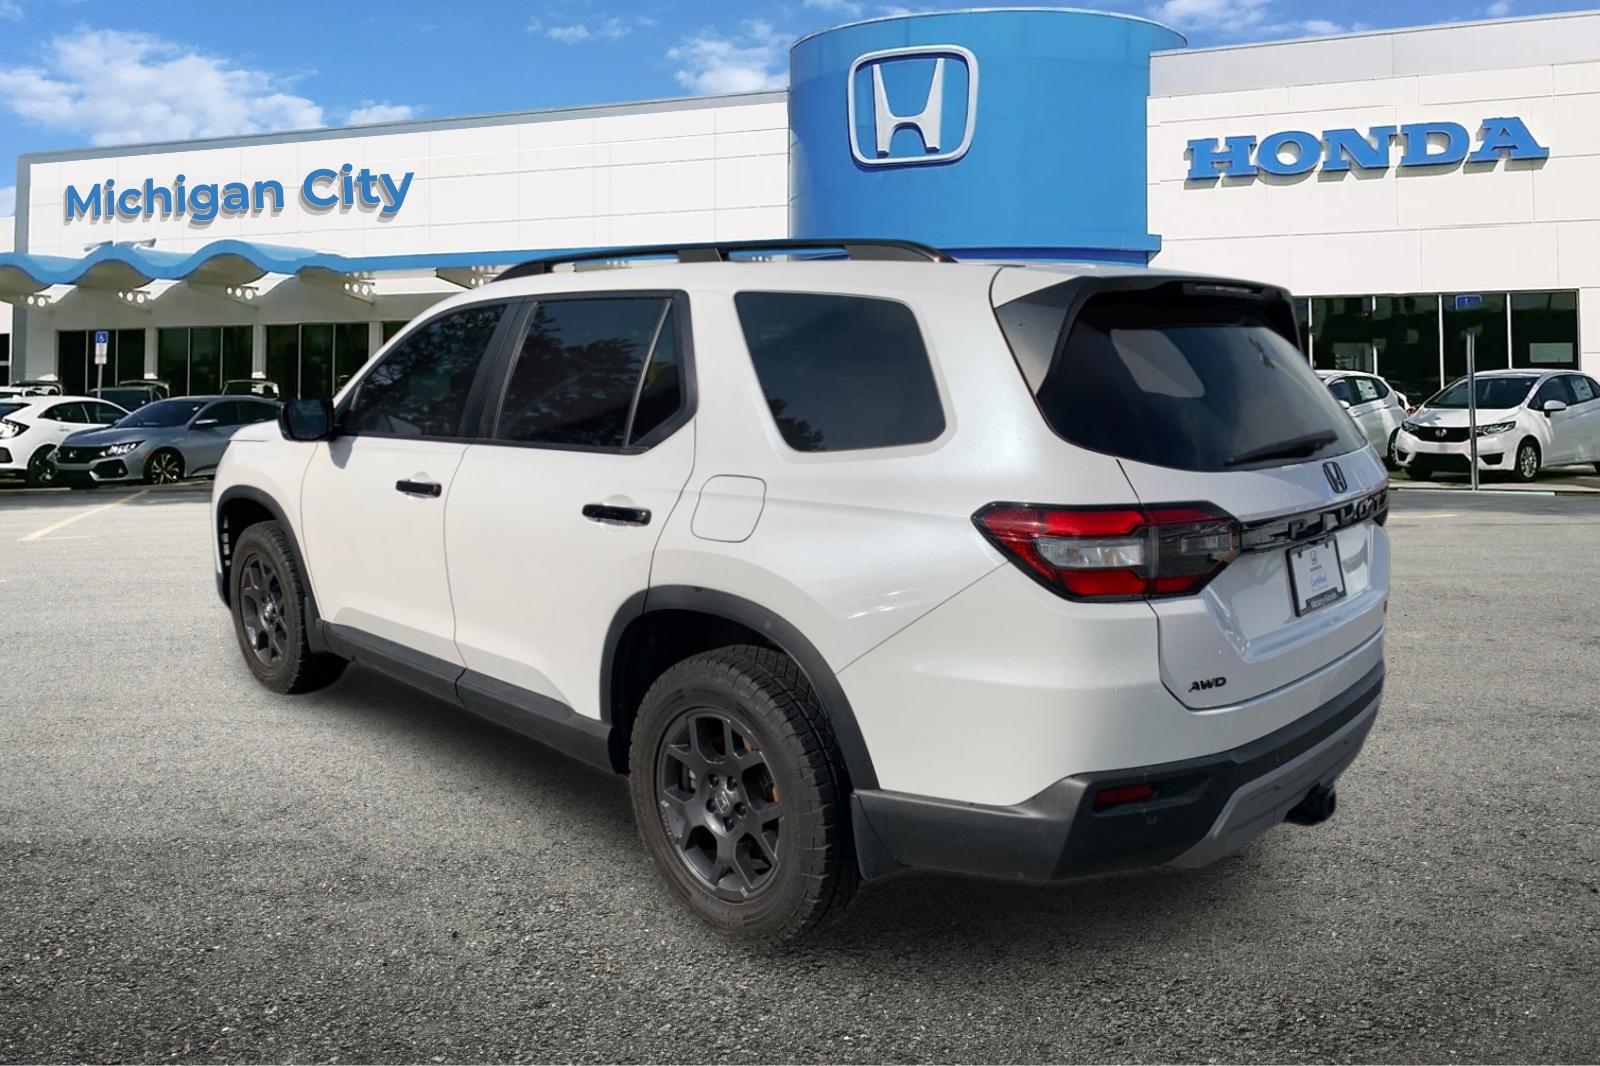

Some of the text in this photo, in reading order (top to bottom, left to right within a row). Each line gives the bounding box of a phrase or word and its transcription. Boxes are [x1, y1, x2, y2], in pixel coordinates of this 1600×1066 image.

[1186, 116, 1549, 181] HONDA
[65, 163, 415, 223] Michigan City
[1188, 676, 1226, 692] AWD
